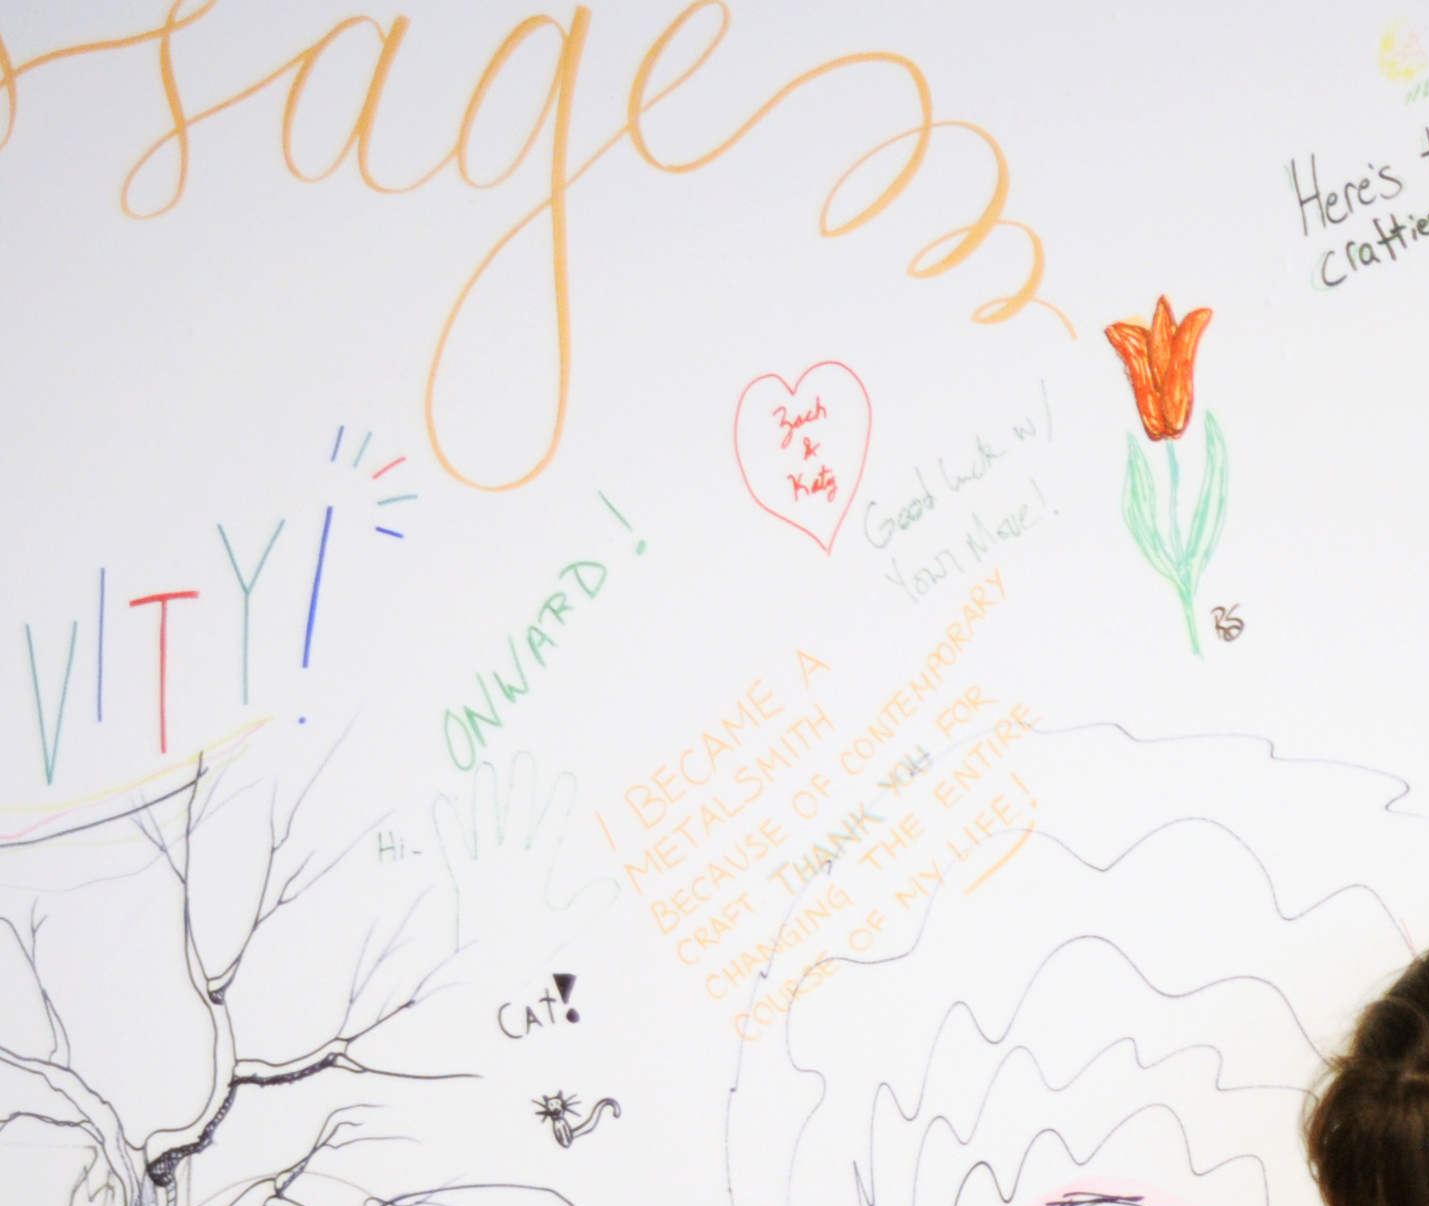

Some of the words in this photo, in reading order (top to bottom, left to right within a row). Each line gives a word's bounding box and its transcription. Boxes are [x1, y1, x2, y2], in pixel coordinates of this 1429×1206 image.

[1291, 153, 1404, 237] Here's
[442, 490, 647, 772] ONWARD!
[623, 679, 786, 830] BECAME
[795, 647, 832, 691] A
[623, 702, 835, 896] METALSMITH
[649, 818, 789, 937] BECAUSE
[791, 773, 833, 819] OF
[839, 567, 1008, 776] CONTEMPORARY
[676, 892, 756, 966] CRAFT
[767, 800, 887, 897] THANK
[935, 685, 999, 739] FOR
[704, 883, 855, 1000] CHANGING
[858, 811, 928, 871] THE
[933, 702, 1043, 810] ENTIRE
[498, 971, 580, 1039] CAT!
[734, 950, 843, 1043] COURSE
[848, 908, 887, 953] OF
[895, 860, 947, 911] MY
